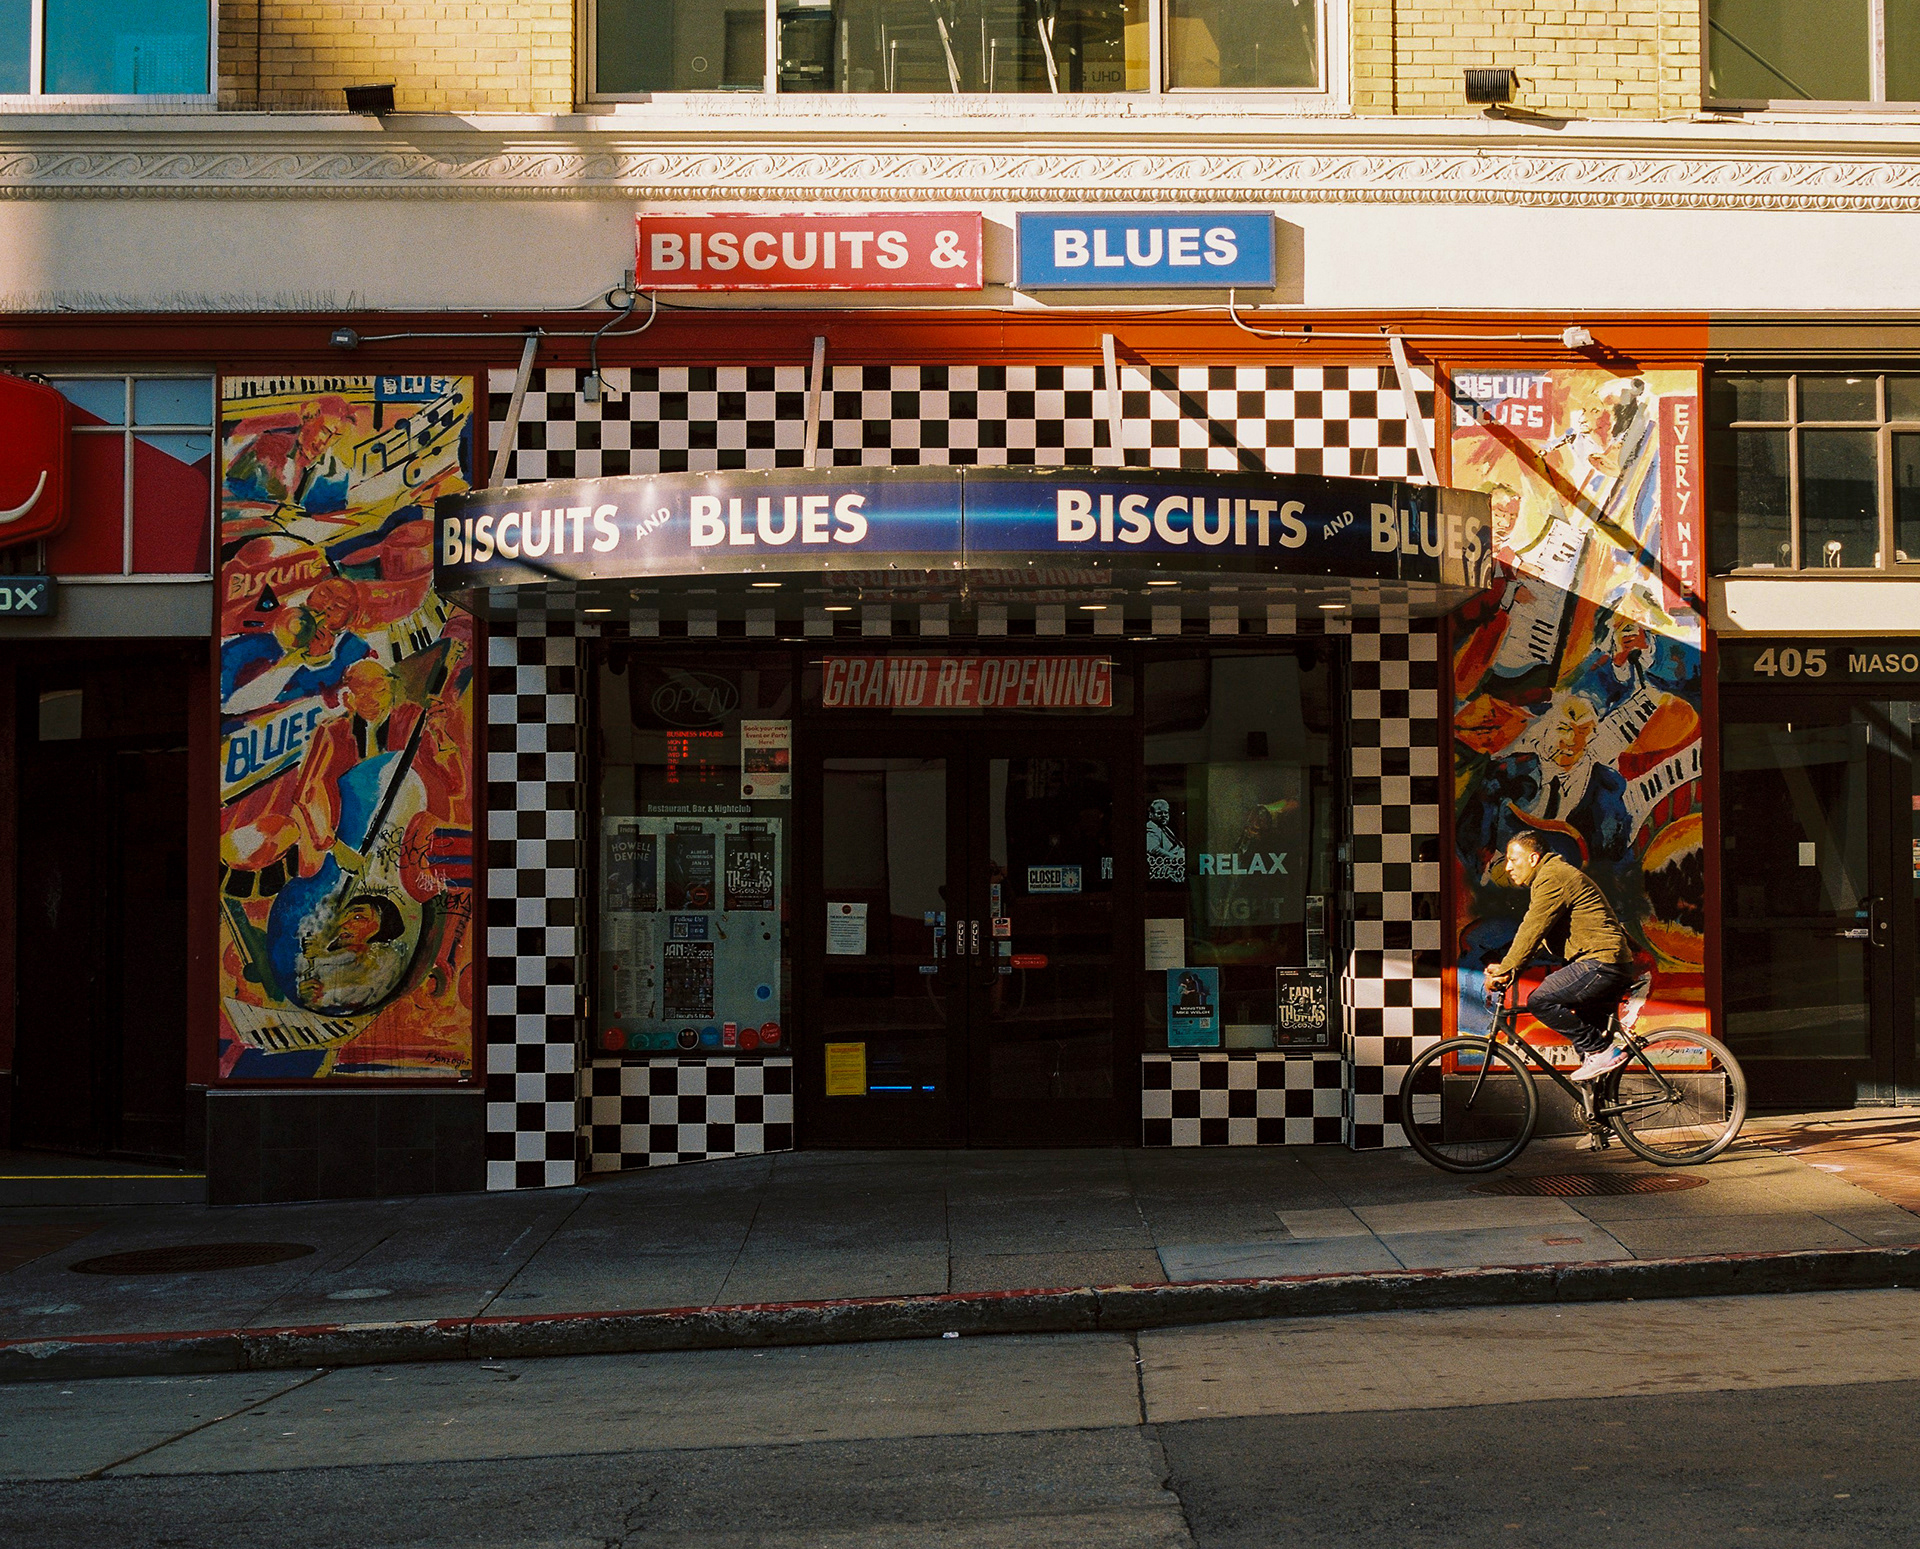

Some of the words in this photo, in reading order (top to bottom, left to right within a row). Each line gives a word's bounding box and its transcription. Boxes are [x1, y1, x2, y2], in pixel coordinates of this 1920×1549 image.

[1091, 70, 1121, 83] UHD
[650, 230, 909, 271] BISCUITS
[930, 230, 968, 269] &
[1053, 227, 1239, 268] BLUES
[1454, 376, 1552, 399] BISCUIT
[1455, 403, 1544, 428] BLUES
[1673, 403, 1691, 516] EVERY
[442, 503, 621, 567] BISCUITS
[635, 507, 672, 541] AND
[690, 494, 868, 547] BLUES
[1057, 489, 1309, 549] BISCUITS
[1322, 510, 1355, 541] AND
[1370, 502, 1482, 563] BLUES
[1676, 521, 1694, 599] NITE
[227, 556, 326, 598] BISCUITS
[1753, 647, 1828, 678] 405
[1848, 653, 1919, 673] MASO
[823, 658, 929, 706] GRAND
[656, 687, 731, 713] OPEN
[647, 804, 692, 814] Restaurant,
[714, 804, 751, 814] Nightclub
[675, 824, 701, 832] Thursday
[611, 841, 652, 853] HOWELL
[614, 851, 650, 863] DEVINE
[1198, 852, 1289, 876] RELAX
[1029, 870, 1061, 884] CLOSED
[1209, 896, 1285, 920] NIGT
[664, 943, 684, 957] JAN
